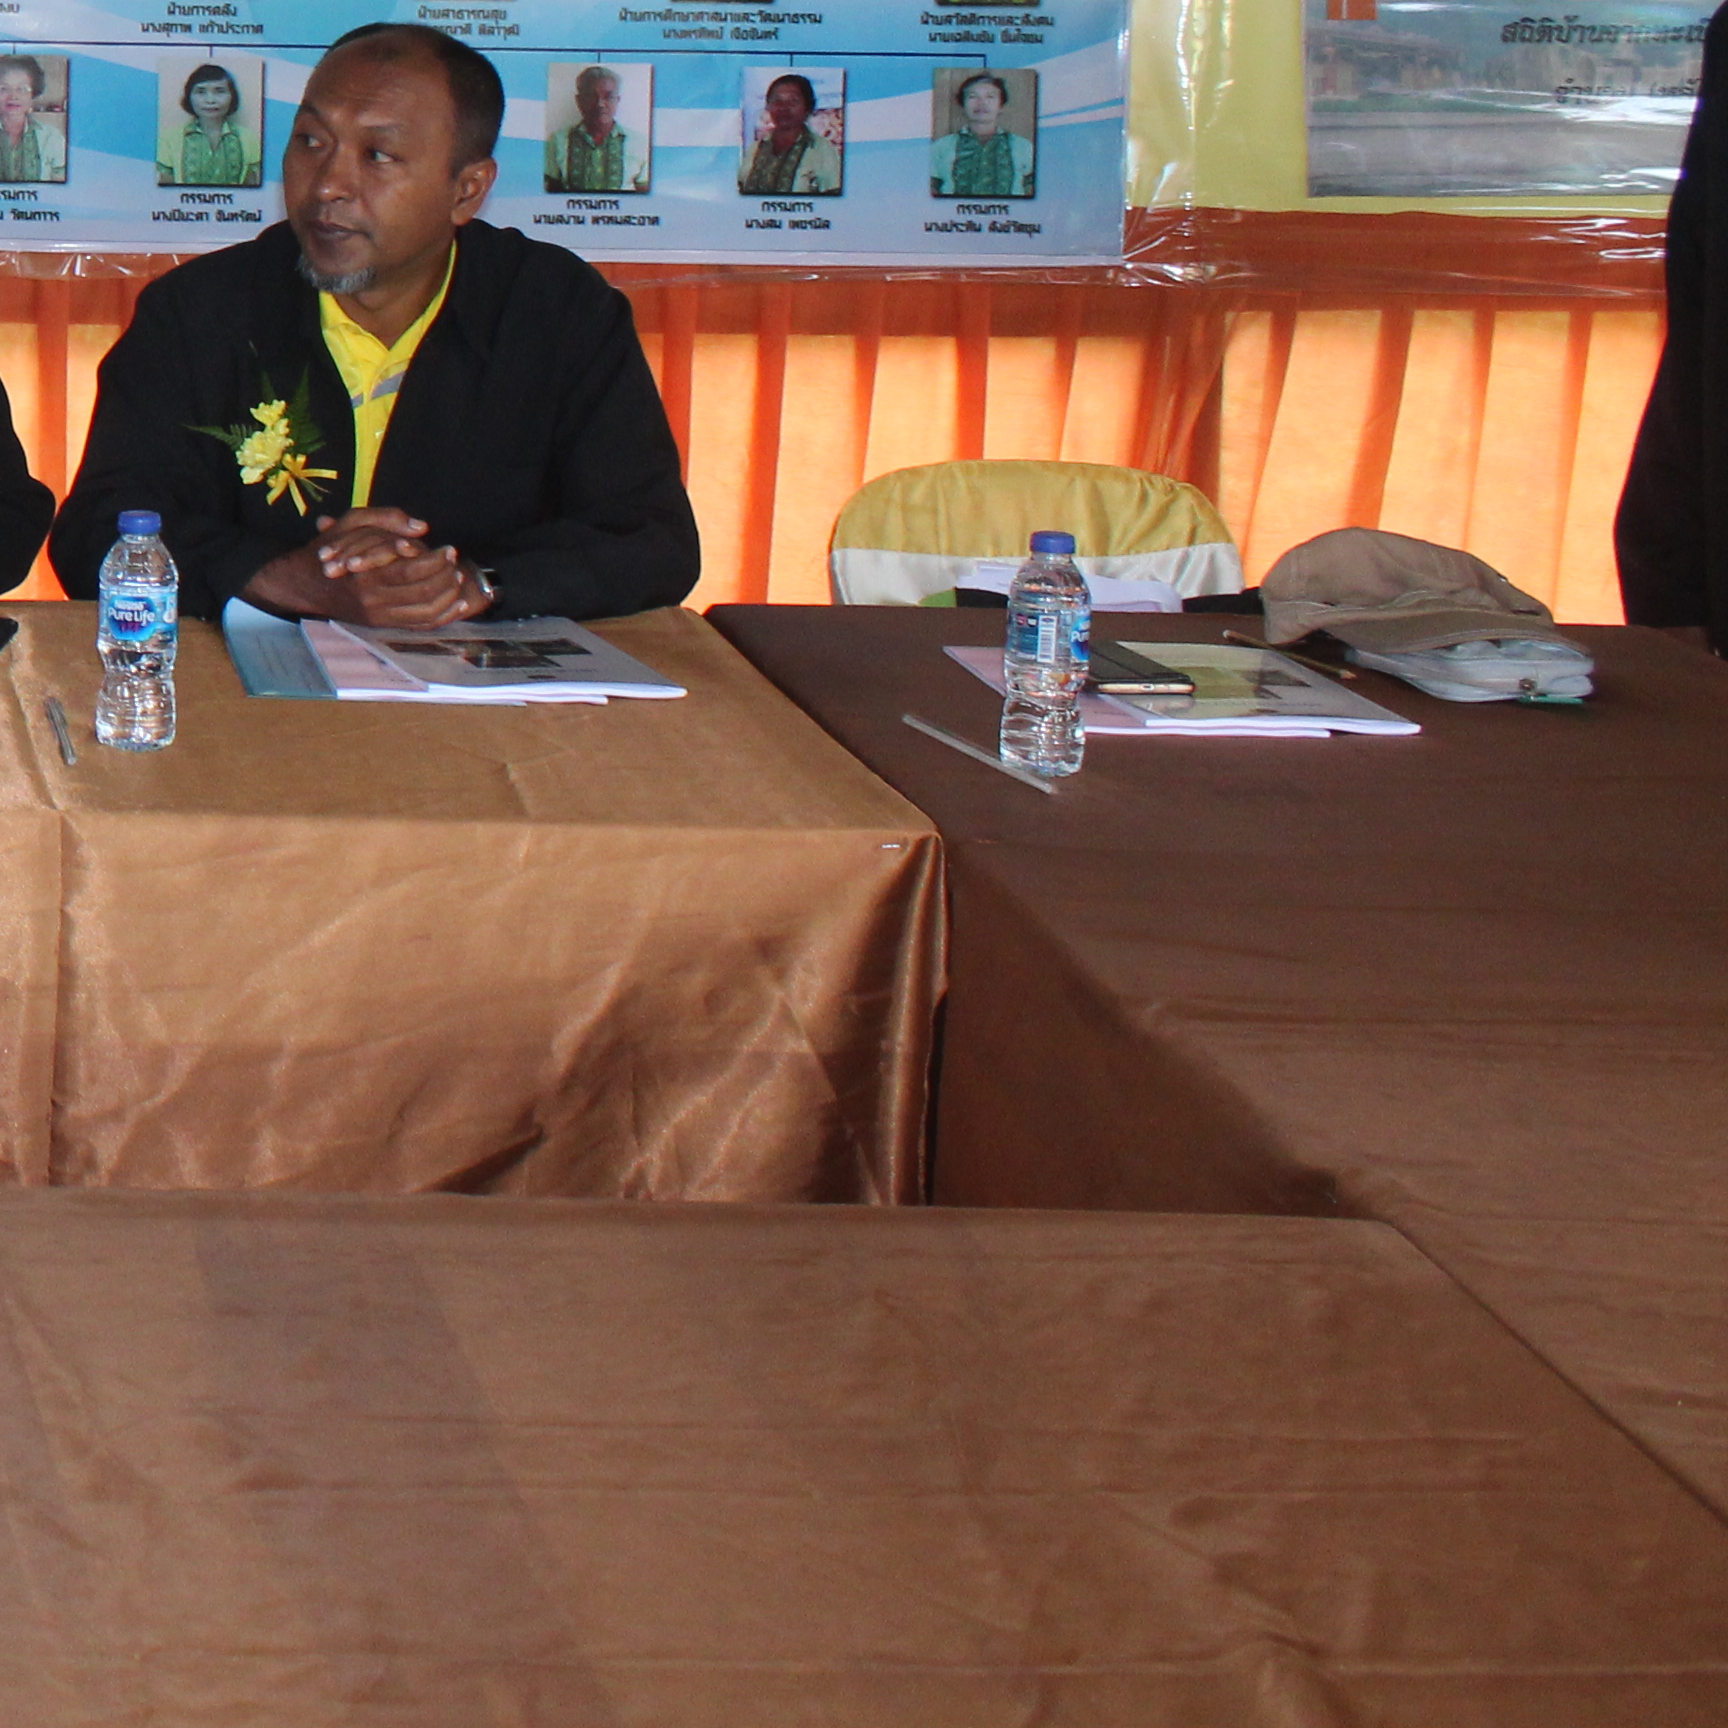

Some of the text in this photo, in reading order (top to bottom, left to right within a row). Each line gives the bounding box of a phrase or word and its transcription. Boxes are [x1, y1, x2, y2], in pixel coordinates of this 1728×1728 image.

[180, 193, 233, 204] กรรมการ
[567, 199, 621, 210] กรรมการ
[762, 201, 813, 212] กรรมการ
[956, 204, 1009, 214] กรรมการ
[108, 607, 156, 626] Pure Life
